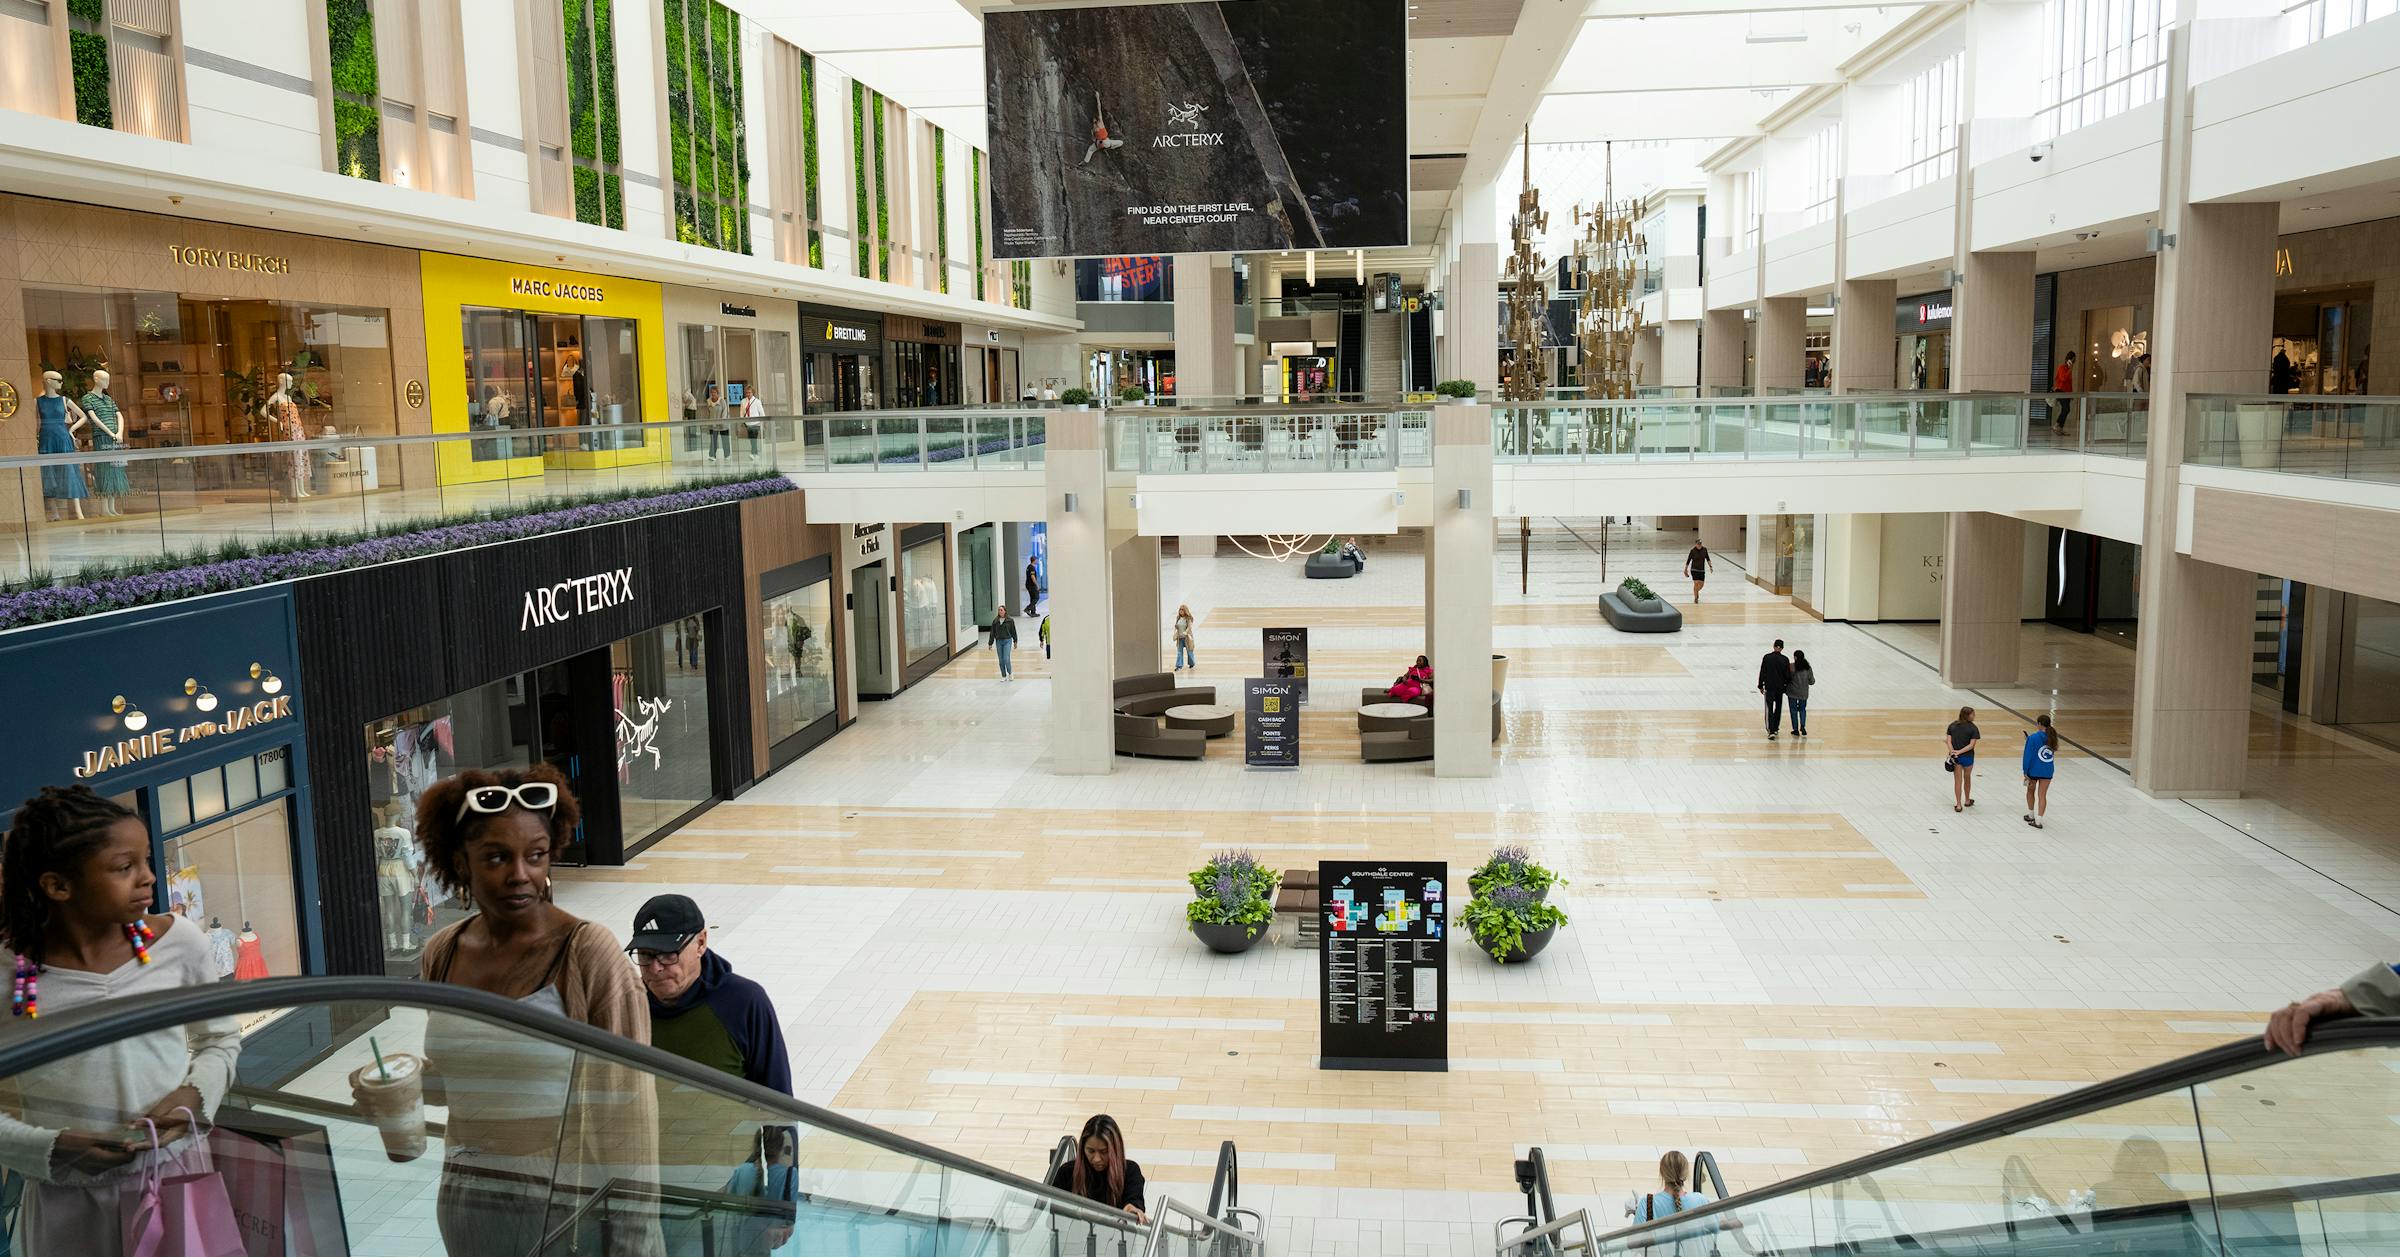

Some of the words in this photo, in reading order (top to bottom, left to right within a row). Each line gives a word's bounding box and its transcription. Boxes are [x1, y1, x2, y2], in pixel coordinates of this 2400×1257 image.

[1152, 133, 1224, 148] ARC'TERYX
[1127, 206, 1148, 215] FIND
[1149, 206, 1162, 214] US
[1163, 205, 1177, 213] ON
[1178, 205, 1197, 213] THE
[1197, 204, 1223, 212] FIRST
[1224, 203, 1254, 212] LEVEL,
[1143, 217, 1168, 225] NEAR
[1169, 216, 1205, 224] CENTER
[1206, 214, 1238, 223] COURT
[169, 244, 223, 268] TORY
[226, 251, 289, 274] BURCH
[512, 278, 551, 297] MARC
[554, 283, 605, 302] JACOBS
[834, 326, 867, 341] BREITLING
[520, 566, 635, 632] ARC'TERYX
[74, 727, 177, 779] JANIE
[178, 721, 218, 743] AND
[218, 694, 294, 735] JACK
